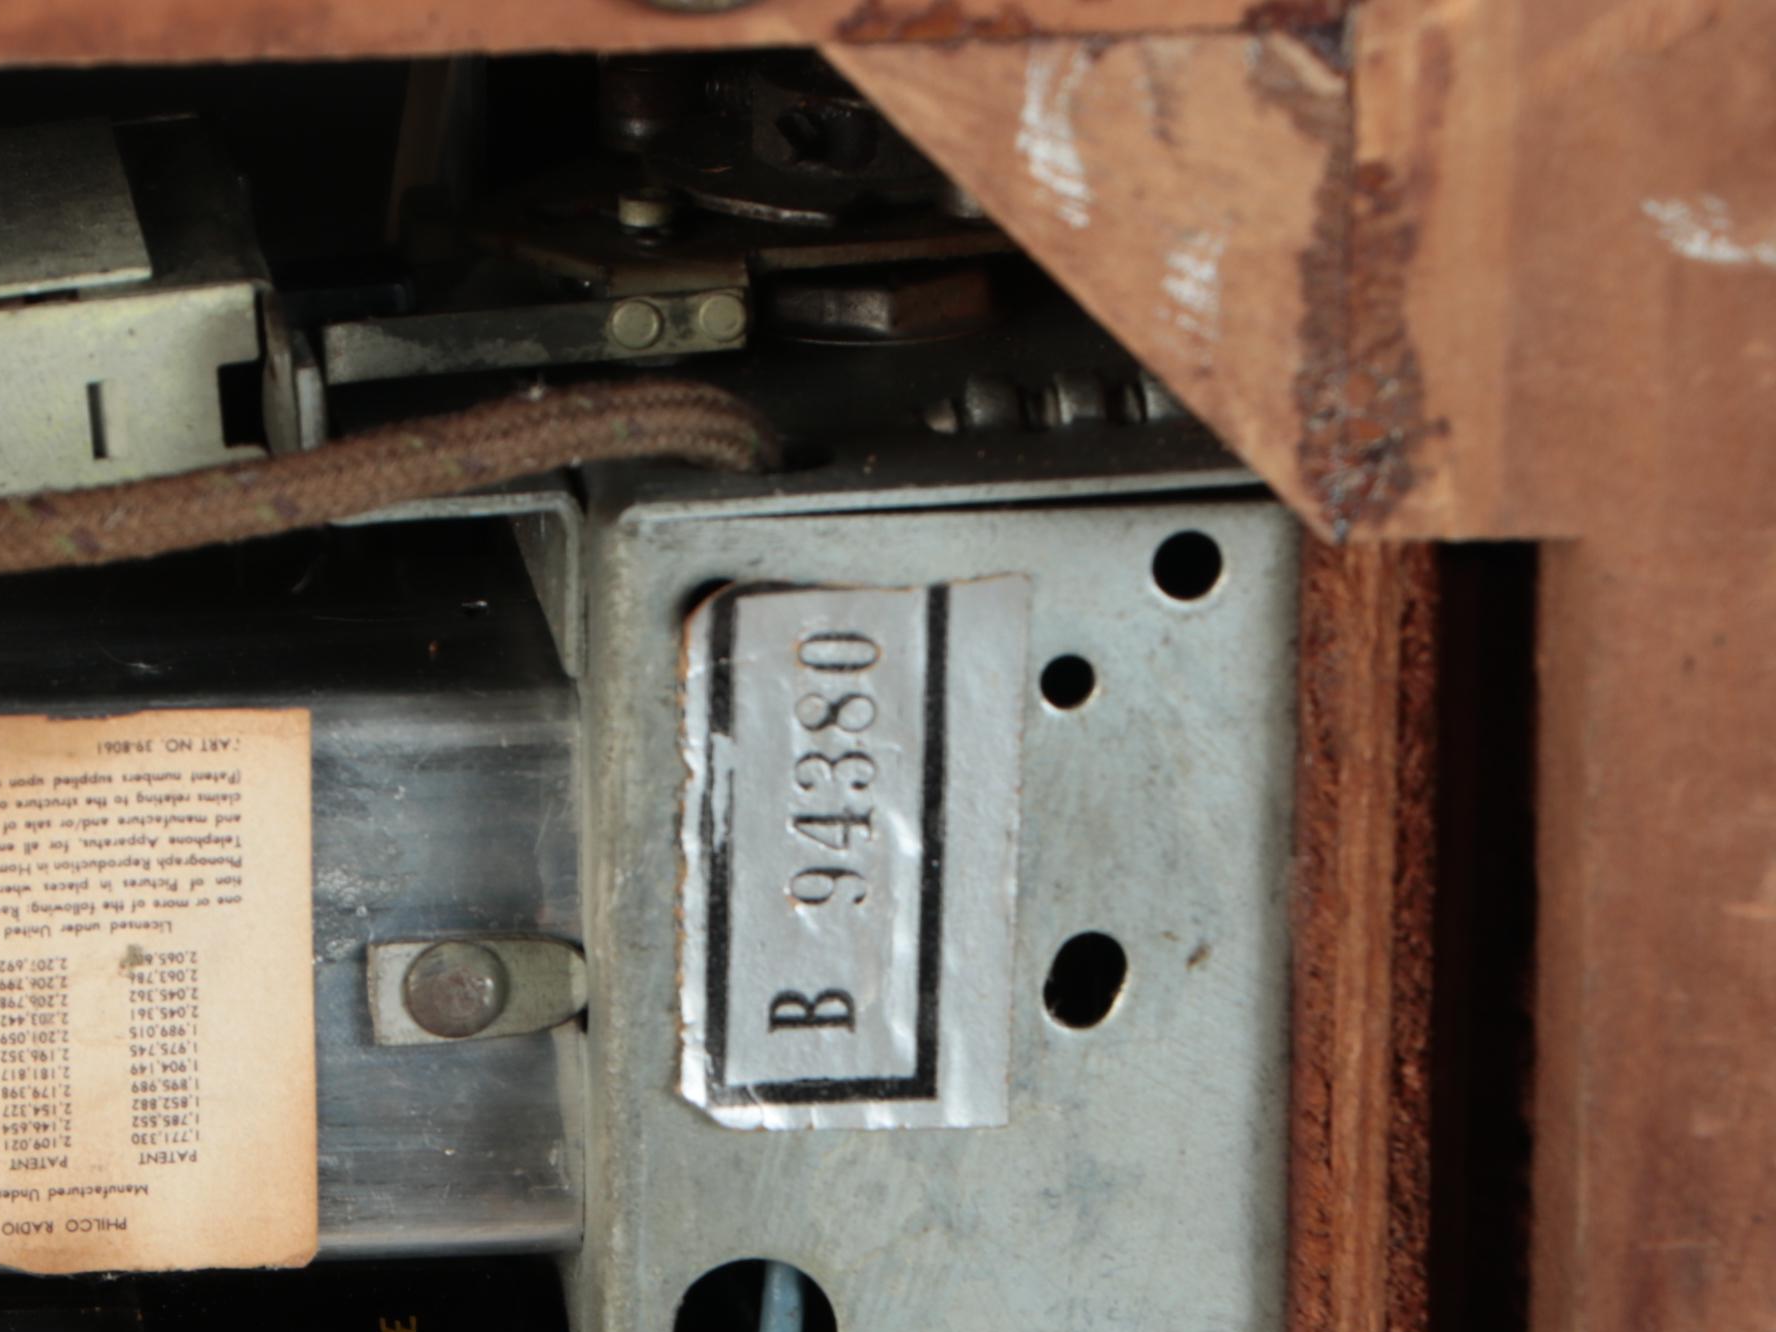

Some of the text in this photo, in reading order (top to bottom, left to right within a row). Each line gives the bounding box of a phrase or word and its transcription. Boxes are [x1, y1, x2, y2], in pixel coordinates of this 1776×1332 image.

[9, 775, 45, 789] upon
[53, 772, 113, 791] supplied
[122, 772, 182, 787] numbers
[190, 769, 241, 785] (Patent
[15, 797, 78, 811] structure
[85, 797, 108, 810] the
[114, 795, 129, 807] to
[136, 791, 191, 808] relating
[197, 793, 242, 806] claims
[2, 821, 18, 836] of
[24, 819, 52, 834] sale
[60, 817, 109, 832] and/or
[117, 815, 208, 830] manufacture
[214, 814, 242, 828] and
[767, 629, 882, 1034] B 94380
[24, 841, 40, 856] all
[48, 841, 70, 854] for
[168, 833, 242, 850] Telephone
[36, 863, 49, 875] in
[54, 855, 151, 874] Reproduction
[157, 853, 243, 870] Phonograph
[43, 878, 89, 895] places
[99, 880, 112, 893] in
[122, 878, 178, 893] Pictures
[189, 878, 205, 893] of
[215, 876, 243, 887] tion
[102, 900, 125, 914] the
[131, 899, 146, 914] of
[152, 899, 189, 909] more
[195, 898, 210, 907] or
[217, 895, 243, 906] one
[4, 925, 52, 940] United
[60, 922, 101, 937] under
[110, 921, 172, 935] Licensed
[129, 1040, 198, 1058] 1,975,745
[2, 1102, 72, 1117] 2,154,327
[132, 1112, 199, 1129] 1,785,552
[4, 1134, 72, 1152] 2,109,021
[131, 1129, 200, 1146] 1,771,330
[9, 1156, 68, 1171] PATENT
[138, 1150, 197, 1166] PATENT
[47, 1184, 149, 1202] Manufactured
[1, 1221, 54, 1237] RADIO
[65, 1217, 128, 1233] PHILCO
